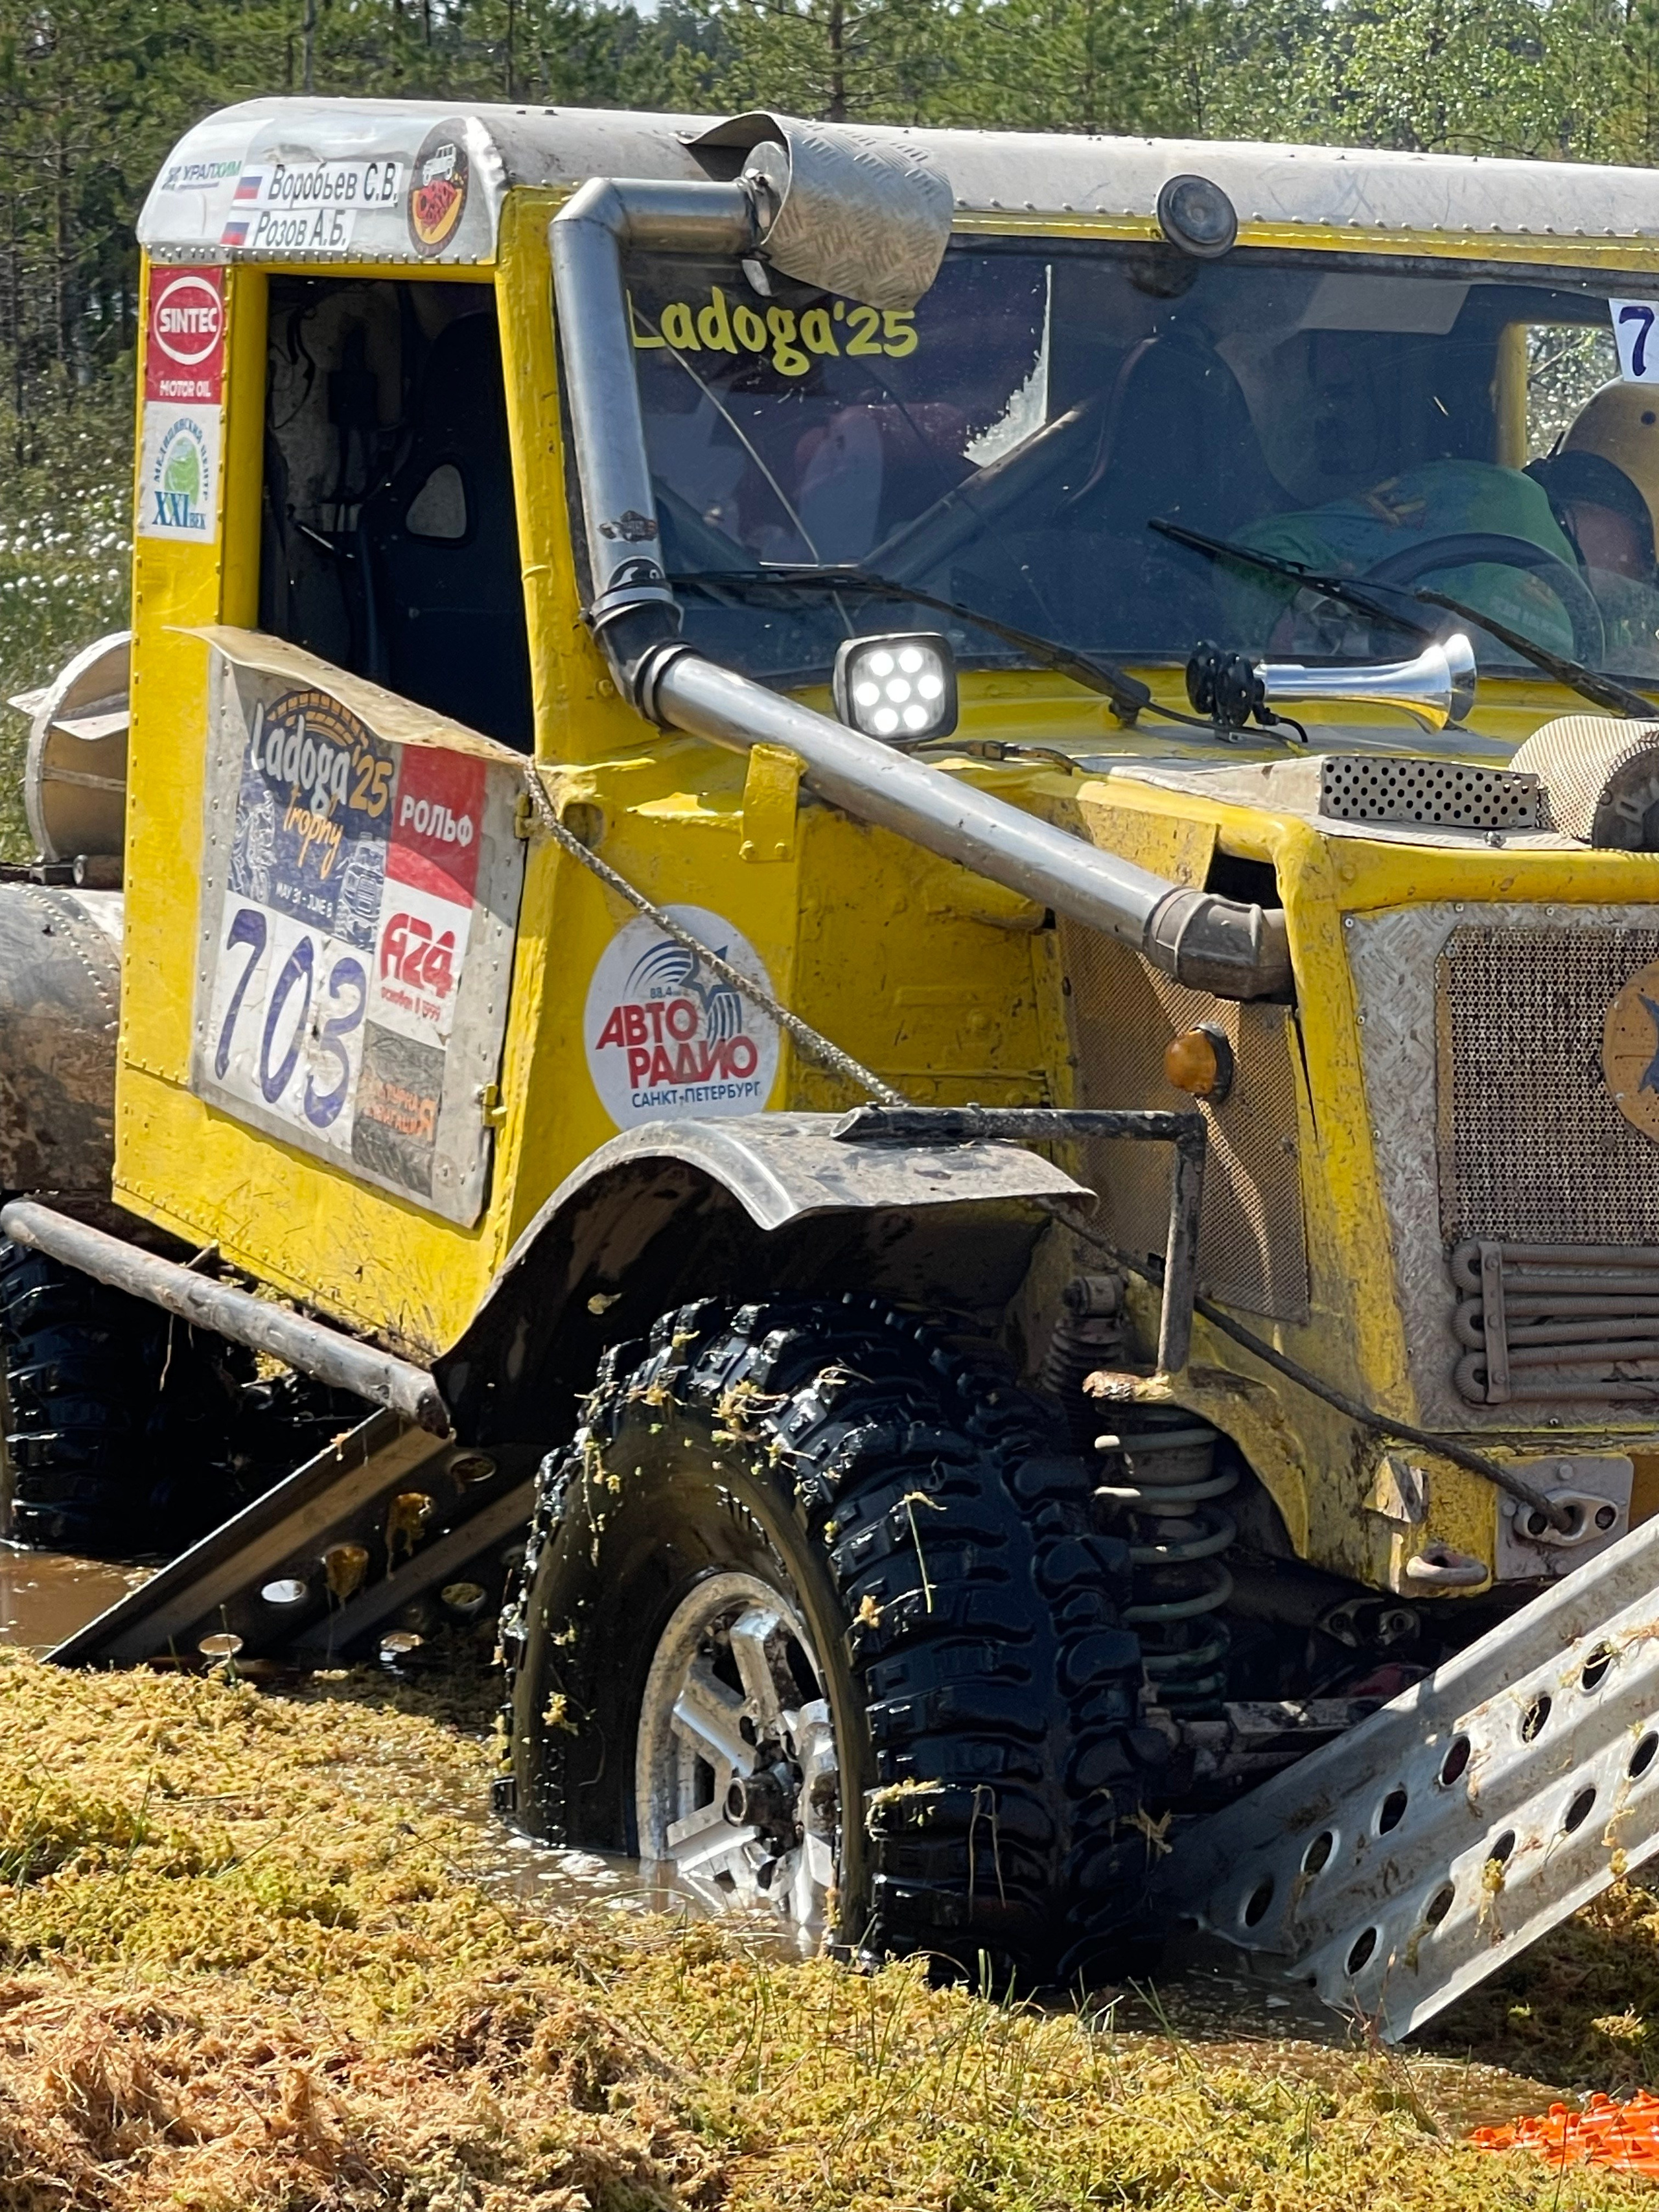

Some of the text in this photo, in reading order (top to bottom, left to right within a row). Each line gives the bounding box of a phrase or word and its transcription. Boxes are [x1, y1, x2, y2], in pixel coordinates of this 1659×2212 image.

[183, 160, 242, 181] УРАЛХИМ
[268, 163, 358, 202] Воробьев
[253, 209, 347, 247] Розов А.Б.
[159, 308, 218, 333] SINTEC
[626, 286, 918, 376] Ladoga'25
[1619, 306, 1655, 377] 7
[159, 380, 211, 397] MOTOR OIL
[249, 701, 393, 818] Ladoga'25
[399, 795, 474, 847] РОЛЬФ
[214, 909, 367, 1129] 703
[595, 998, 699, 1050] АВТО
[627, 1035, 758, 1089] РАДИО
[632, 1081, 761, 1108] САНКТ-ПЕТЕРБУРГ
